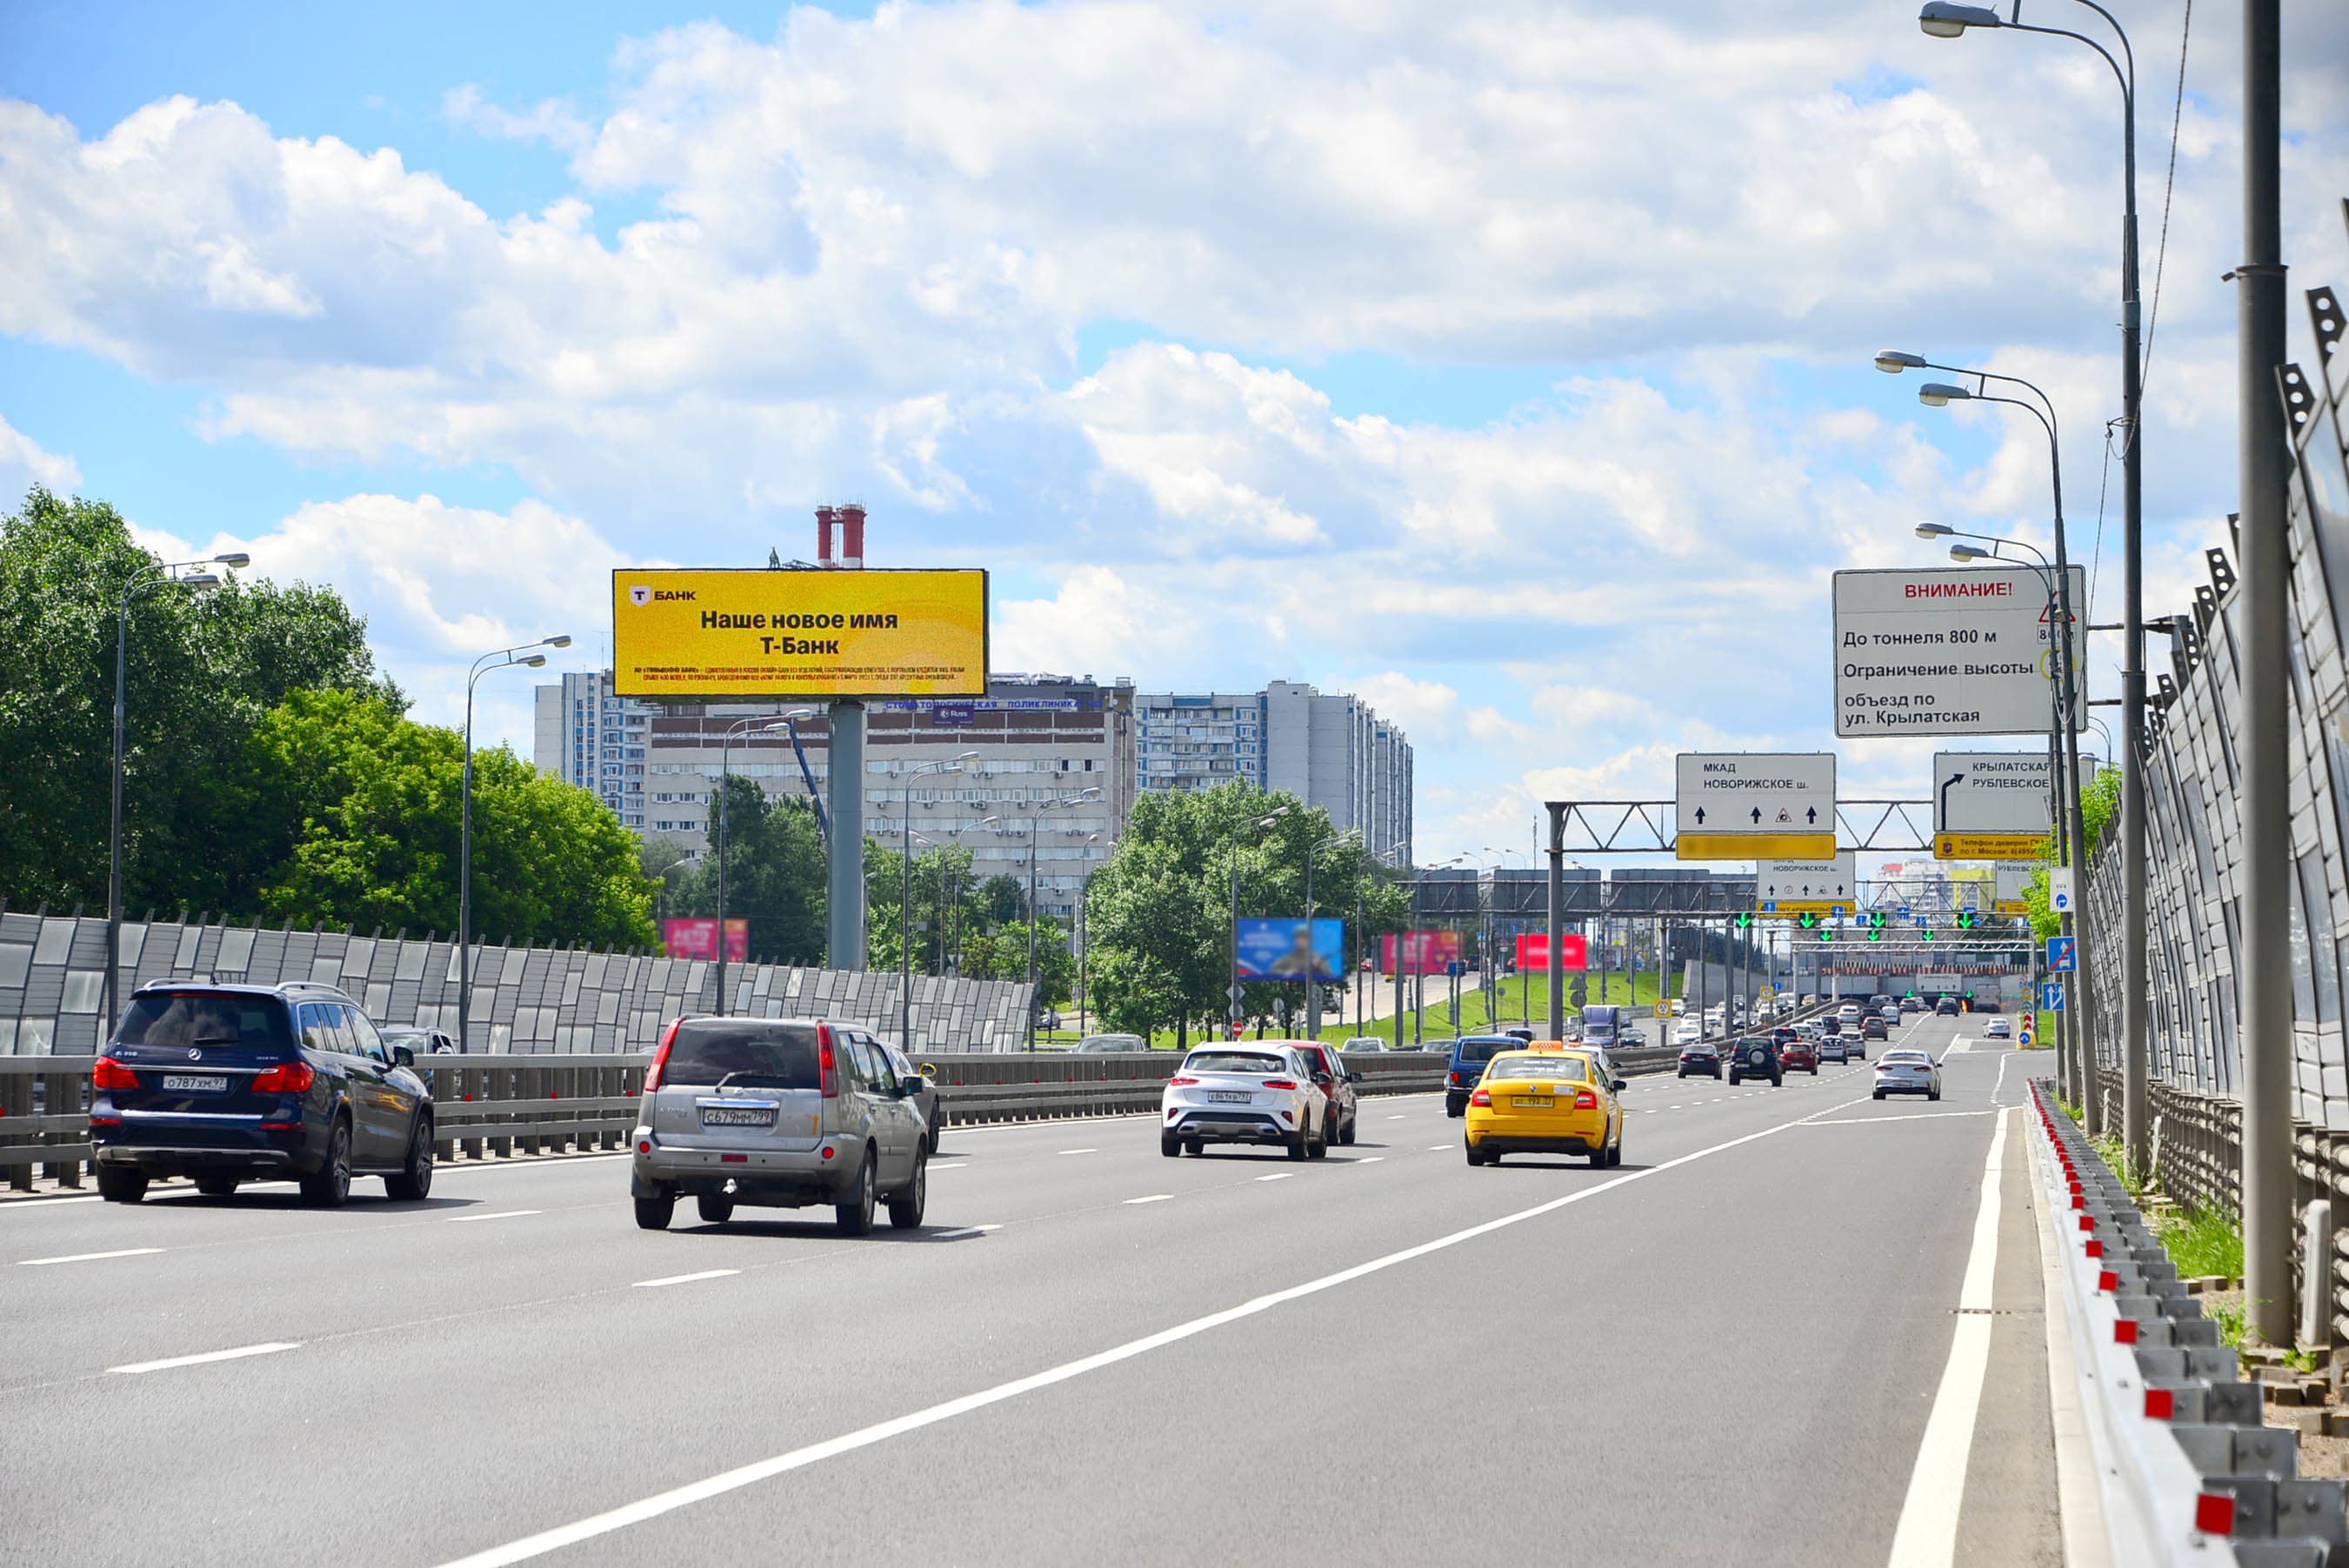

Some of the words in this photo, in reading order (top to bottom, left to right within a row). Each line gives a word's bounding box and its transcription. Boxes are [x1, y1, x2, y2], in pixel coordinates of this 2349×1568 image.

[654, 591, 697, 601] БАНК
[1905, 582, 2012, 598] ВНИМАНИЕ!
[701, 611, 766, 629] Наше
[771, 613, 844, 629] новое
[850, 613, 898, 629] имя
[759, 636, 840, 654] Т-Банк
[1843, 631, 1868, 648] До
[1872, 632, 1944, 645] тоннеля
[1949, 629, 1979, 644] 800
[1984, 631, 1997, 643] м
[1844, 663, 1958, 680] Ограничение
[1964, 663, 2033, 675] высоты
[1008, 699, 1080, 709] ПОЛИКЛИНИКА
[1845, 693, 1909, 708] объезд
[1913, 695, 1935, 706] по
[1845, 713, 1870, 728] ул.
[1876, 710, 1980, 727] Крылатская
[1703, 763, 1737, 774] МКАД
[1972, 762, 2050, 772] КРЫЛАТСКАЯ
[1703, 778, 1793, 789] НОВОРИЖСКОЕ
[1972, 778, 2050, 788] РУБЛЕВСКОЕ
[1960, 838, 1994, 847] Телефон
